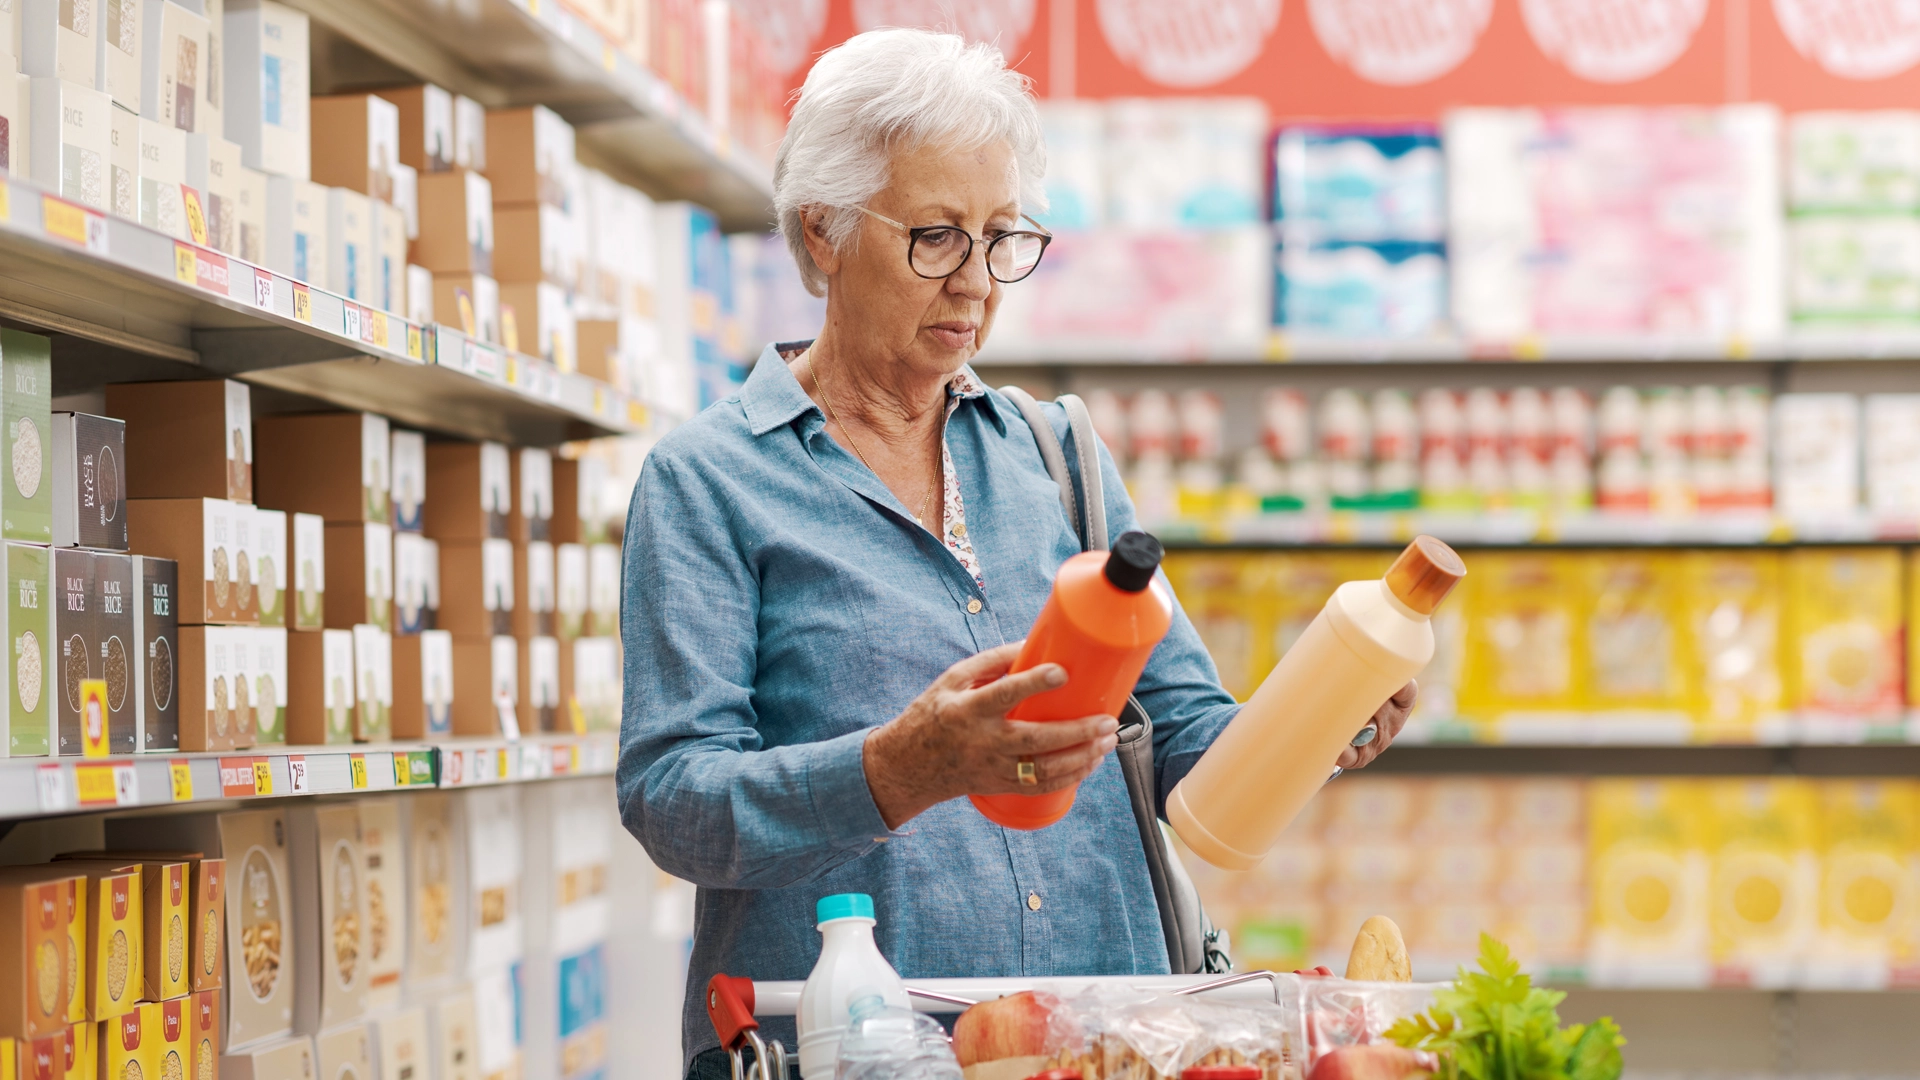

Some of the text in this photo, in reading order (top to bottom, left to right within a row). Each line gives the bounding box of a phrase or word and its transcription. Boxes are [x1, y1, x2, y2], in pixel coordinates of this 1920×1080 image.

[165, 74, 173, 119] RICE
[64, 106, 83, 128] RICE
[111, 129, 119, 147] CE
[142, 143, 159, 162] RICE
[210, 159, 223, 178] RICE
[15, 374, 37, 396] RICE
[19, 578, 37, 591] ORGANIC
[66, 577, 84, 592] BLACK
[103, 580, 121, 595] BLACK
[153, 583, 168, 597] BLACK
[20, 590, 38, 609] RICE
[67, 594, 85, 612] RICE
[104, 596, 122, 614] RICE
[153, 598, 169, 616] RICE
[115, 892, 125, 903] Pasta
[202, 1004, 210, 1015] Pasta
[126, 1023, 136, 1034] Pasta
[167, 1015, 177, 1026] Pasta
